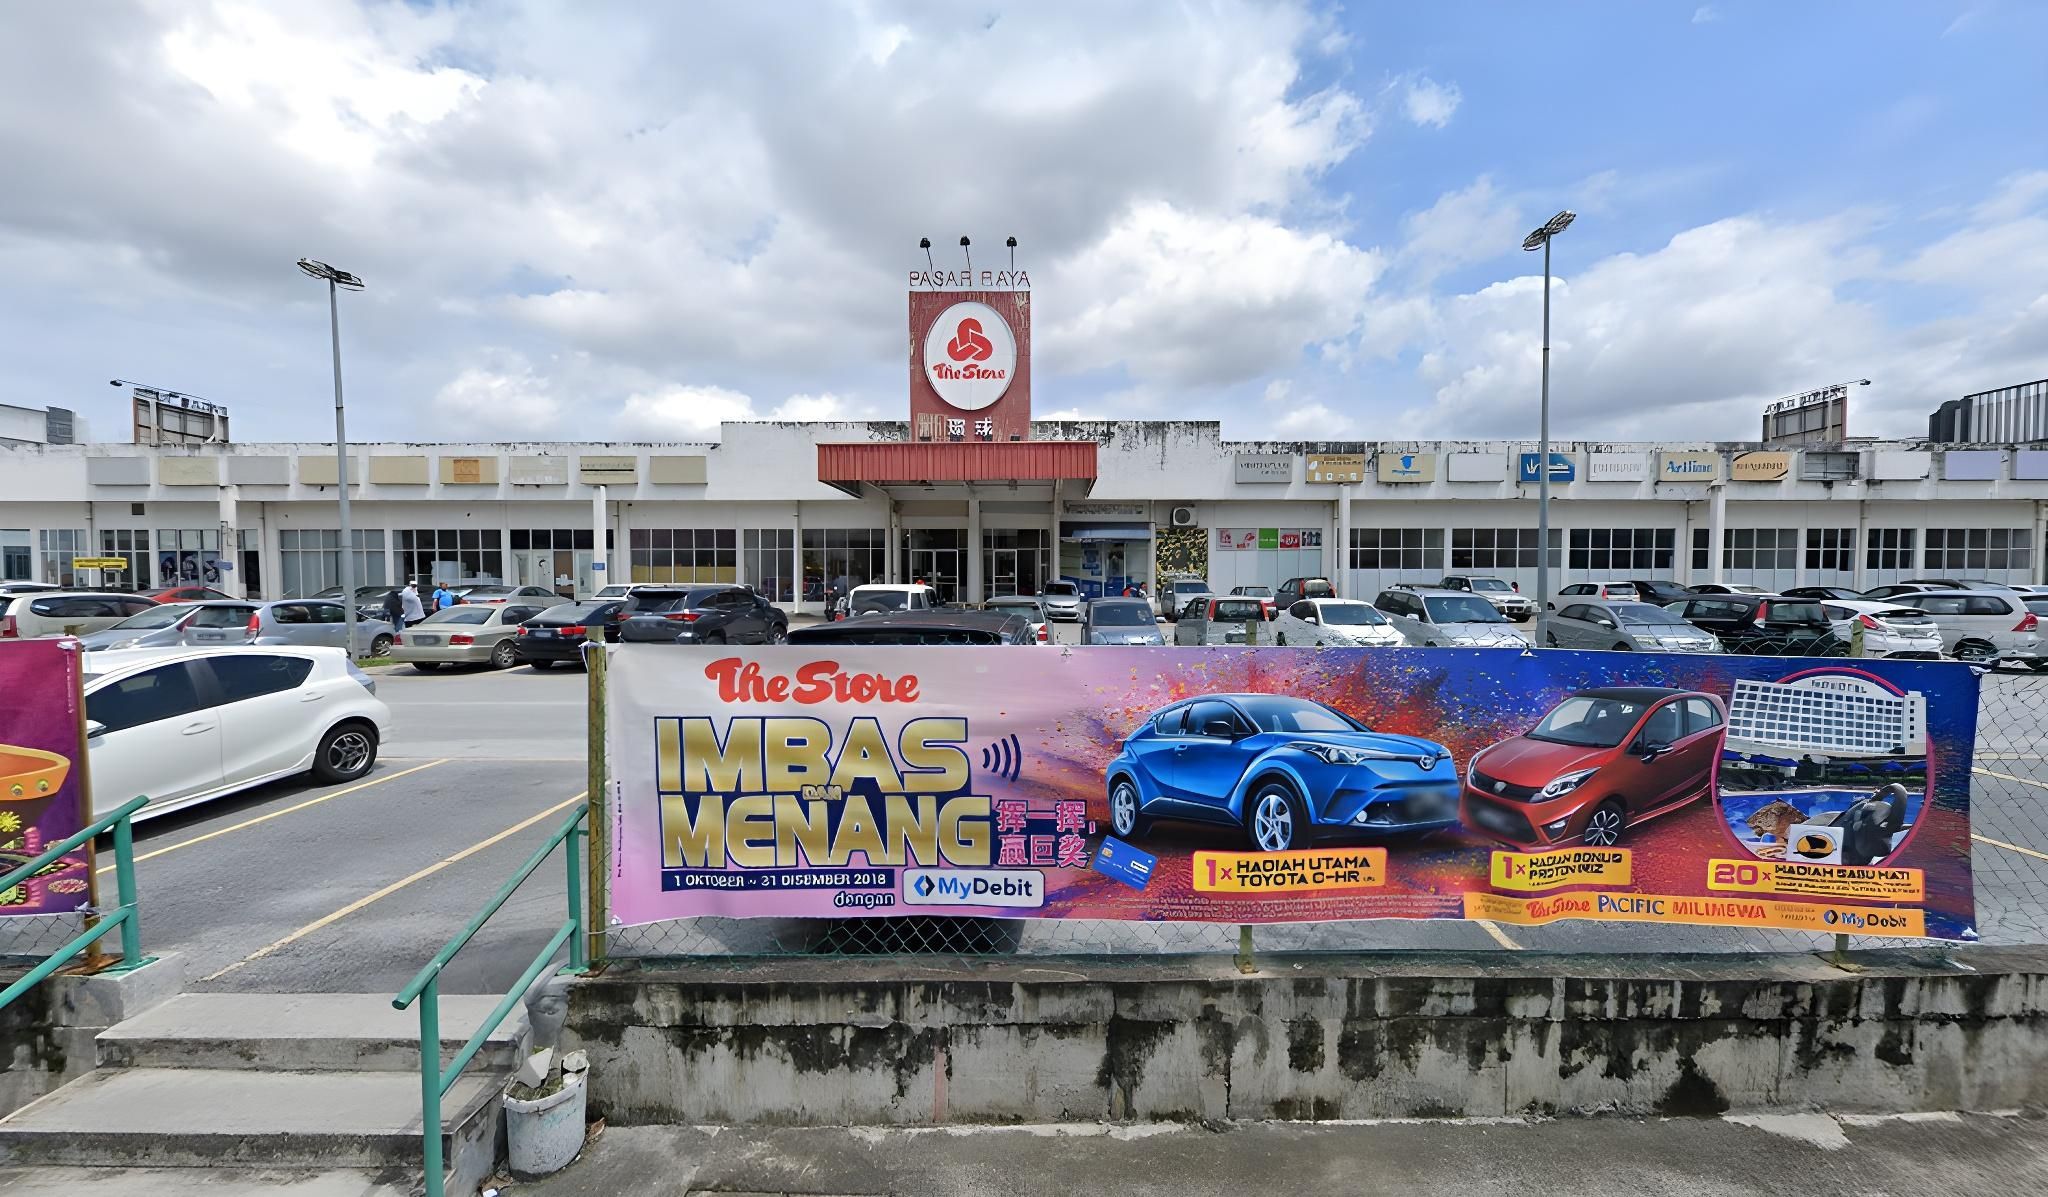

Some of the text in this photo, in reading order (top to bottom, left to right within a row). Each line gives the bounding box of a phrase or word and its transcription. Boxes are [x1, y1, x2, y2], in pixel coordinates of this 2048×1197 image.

[909, 270, 1031, 288] PASAR RAYA
[933, 363, 1006, 380] The Store
[704, 657, 920, 704] The Store
[654, 716, 974, 793] IMBAS
[801, 785, 842, 801] DAN
[659, 794, 994, 868] MENANG
[1236, 858, 1305, 874] HADIAH
[1308, 856, 1371, 870] UTAMA
[674, 875, 681, 887] 1
[685, 874, 745, 887] OKTOBER
[761, 875, 777, 887] 31
[781, 873, 851, 886] DISEMBER
[1236, 872, 1309, 888] TOYOTA
[1714, 863, 1759, 886] 20
[937, 875, 1033, 899] MyDebit
[834, 891, 895, 909] dengan
[1597, 895, 1665, 915] PACIFIC
[1672, 901, 1767, 919] MILIMEWA
